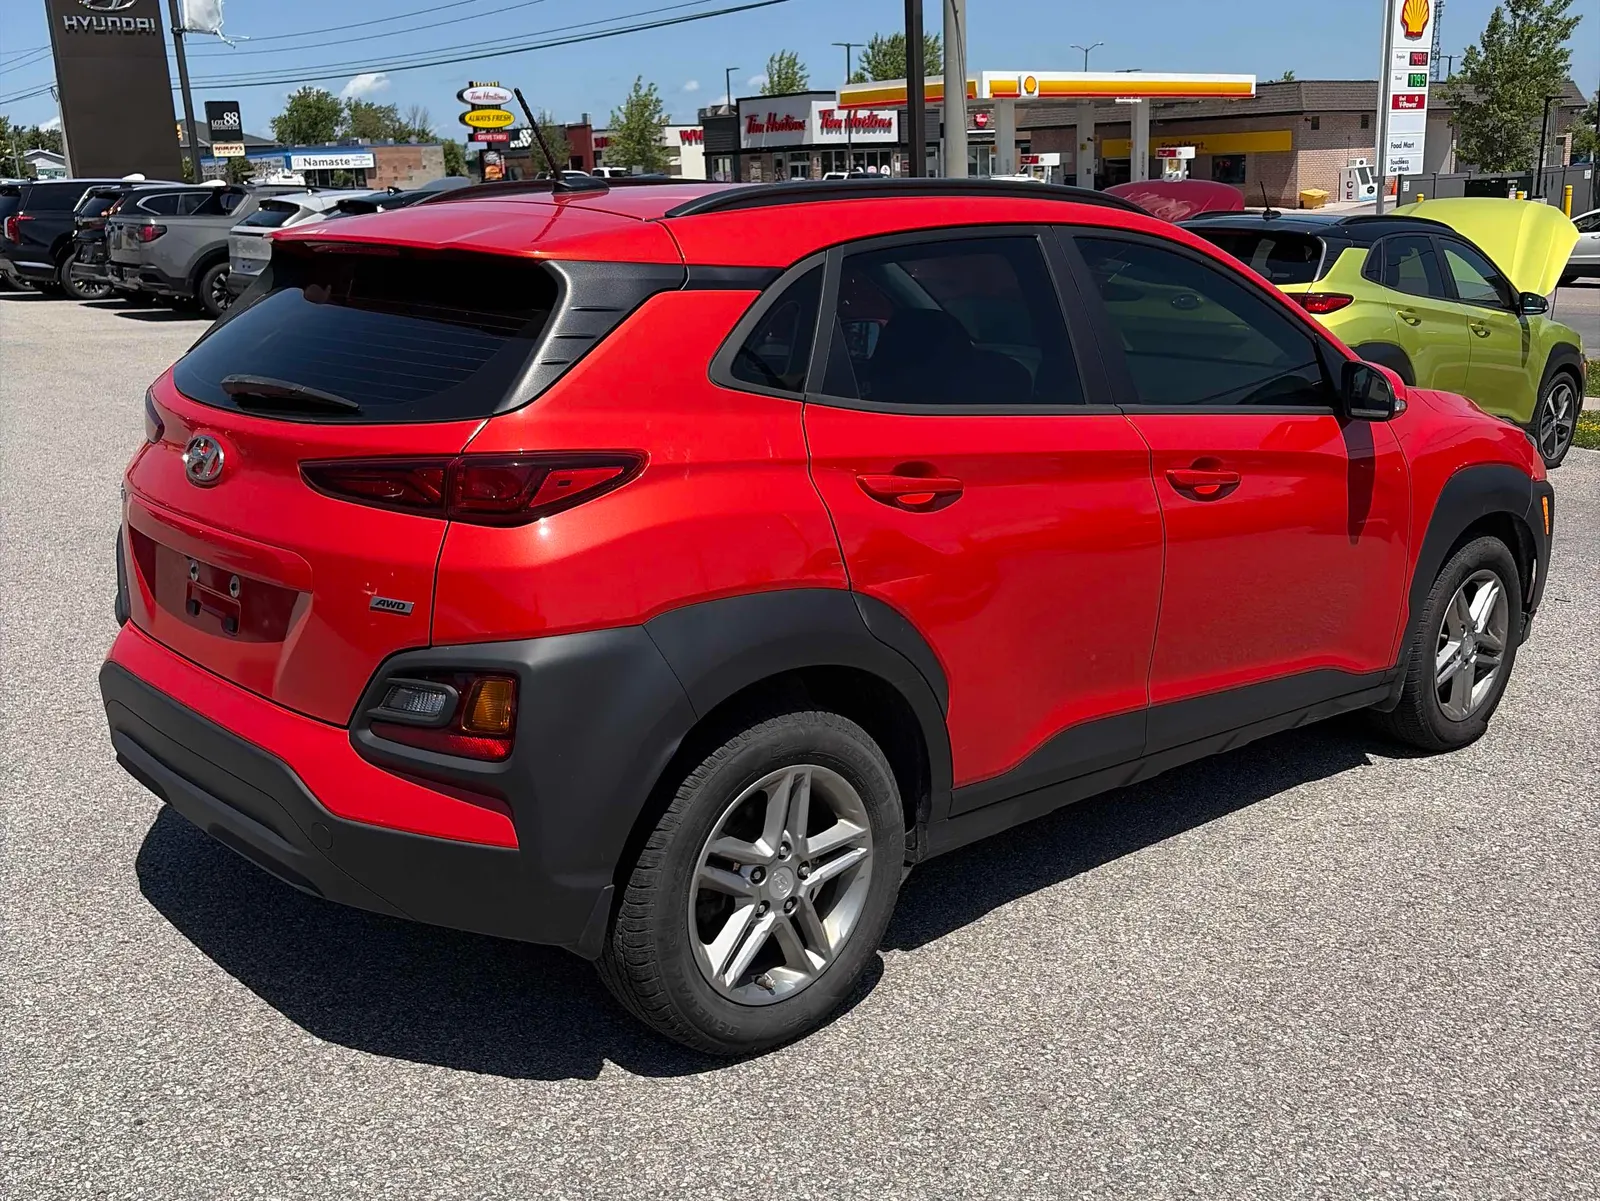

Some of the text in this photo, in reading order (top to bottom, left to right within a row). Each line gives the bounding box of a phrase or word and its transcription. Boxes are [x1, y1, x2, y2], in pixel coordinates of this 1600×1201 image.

[63, 15, 155, 32] HYUNDAI
[492, 114, 511, 122] FRESH
[745, 112, 805, 133] Tim Hortons
[818, 109, 842, 129] Tim
[1391, 141, 1402, 149] Food
[304, 157, 350, 167] Namaste
[1346, 170, 1354, 200] ICE
[375, 599, 406, 610] AWD
